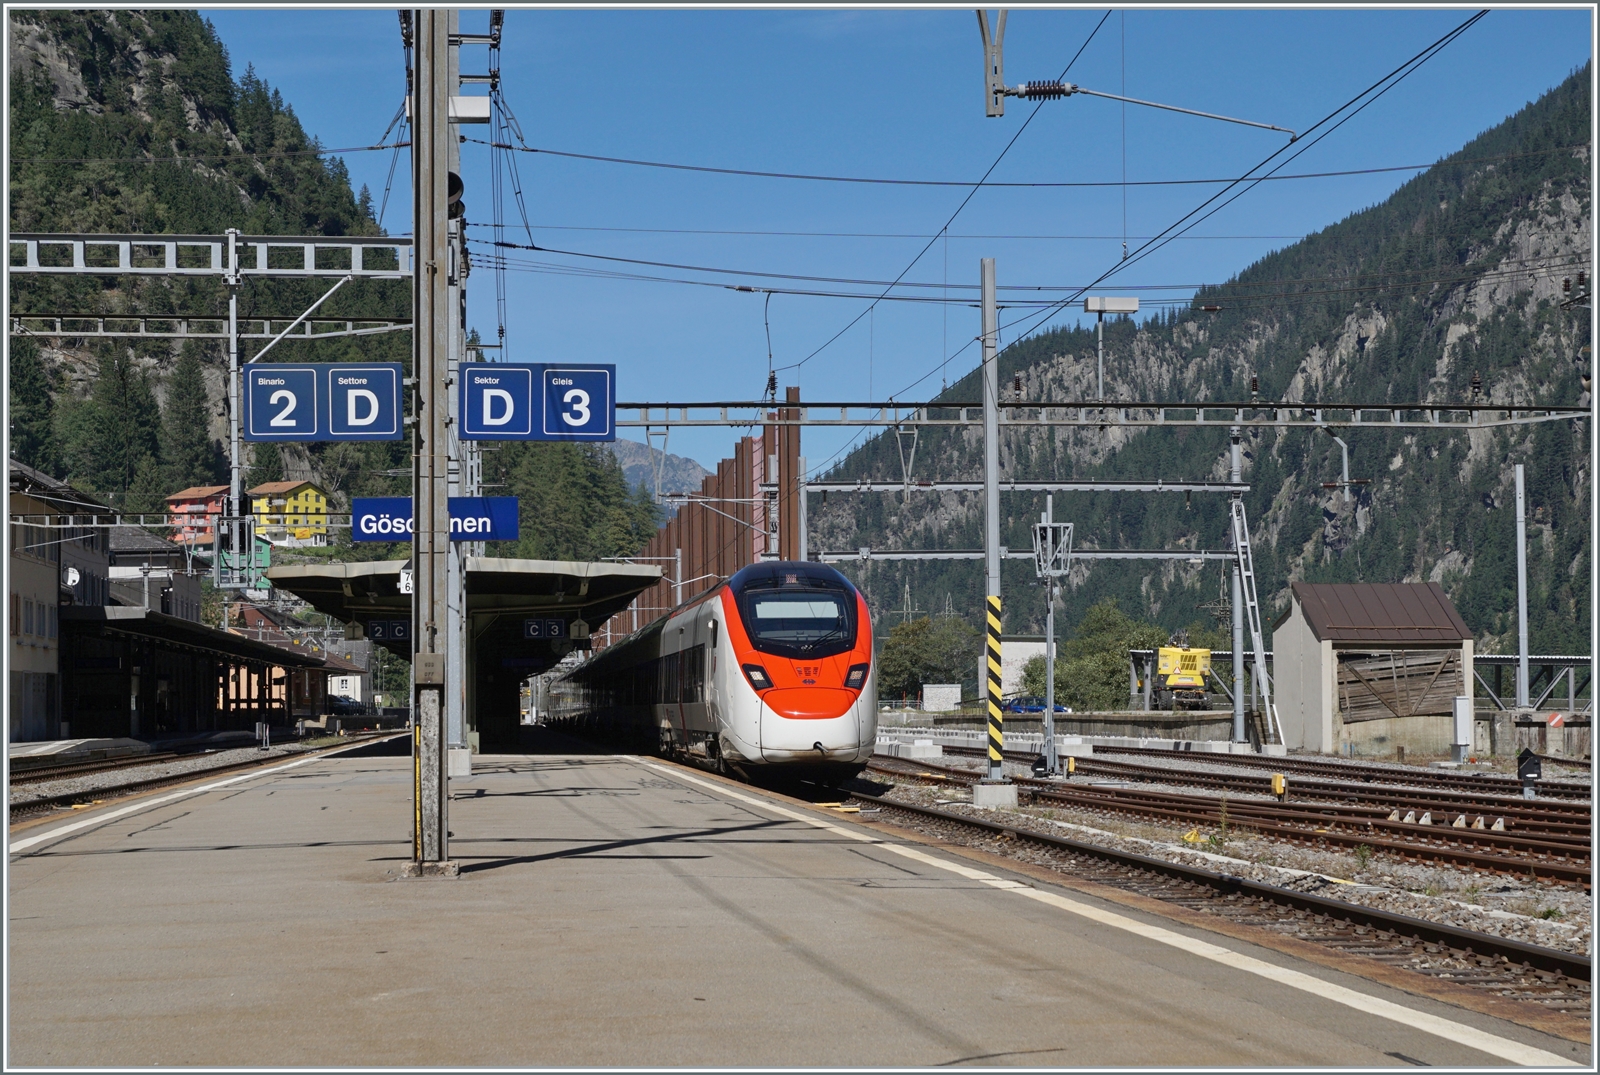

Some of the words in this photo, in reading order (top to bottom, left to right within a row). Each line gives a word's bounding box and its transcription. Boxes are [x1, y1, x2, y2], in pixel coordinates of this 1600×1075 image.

[338, 377, 367, 385] Settore
[269, 389, 297, 426] 2
[347, 389, 379, 426] D
[483, 389, 514, 425] D
[562, 389, 590, 426] 3
[360, 514, 491, 534] Göscnen
[405, 582, 413, 592] 6
[374, 626, 383, 637] 2
[394, 626, 404, 637] C
[529, 624, 539, 636] C
[550, 624, 559, 636] 3
